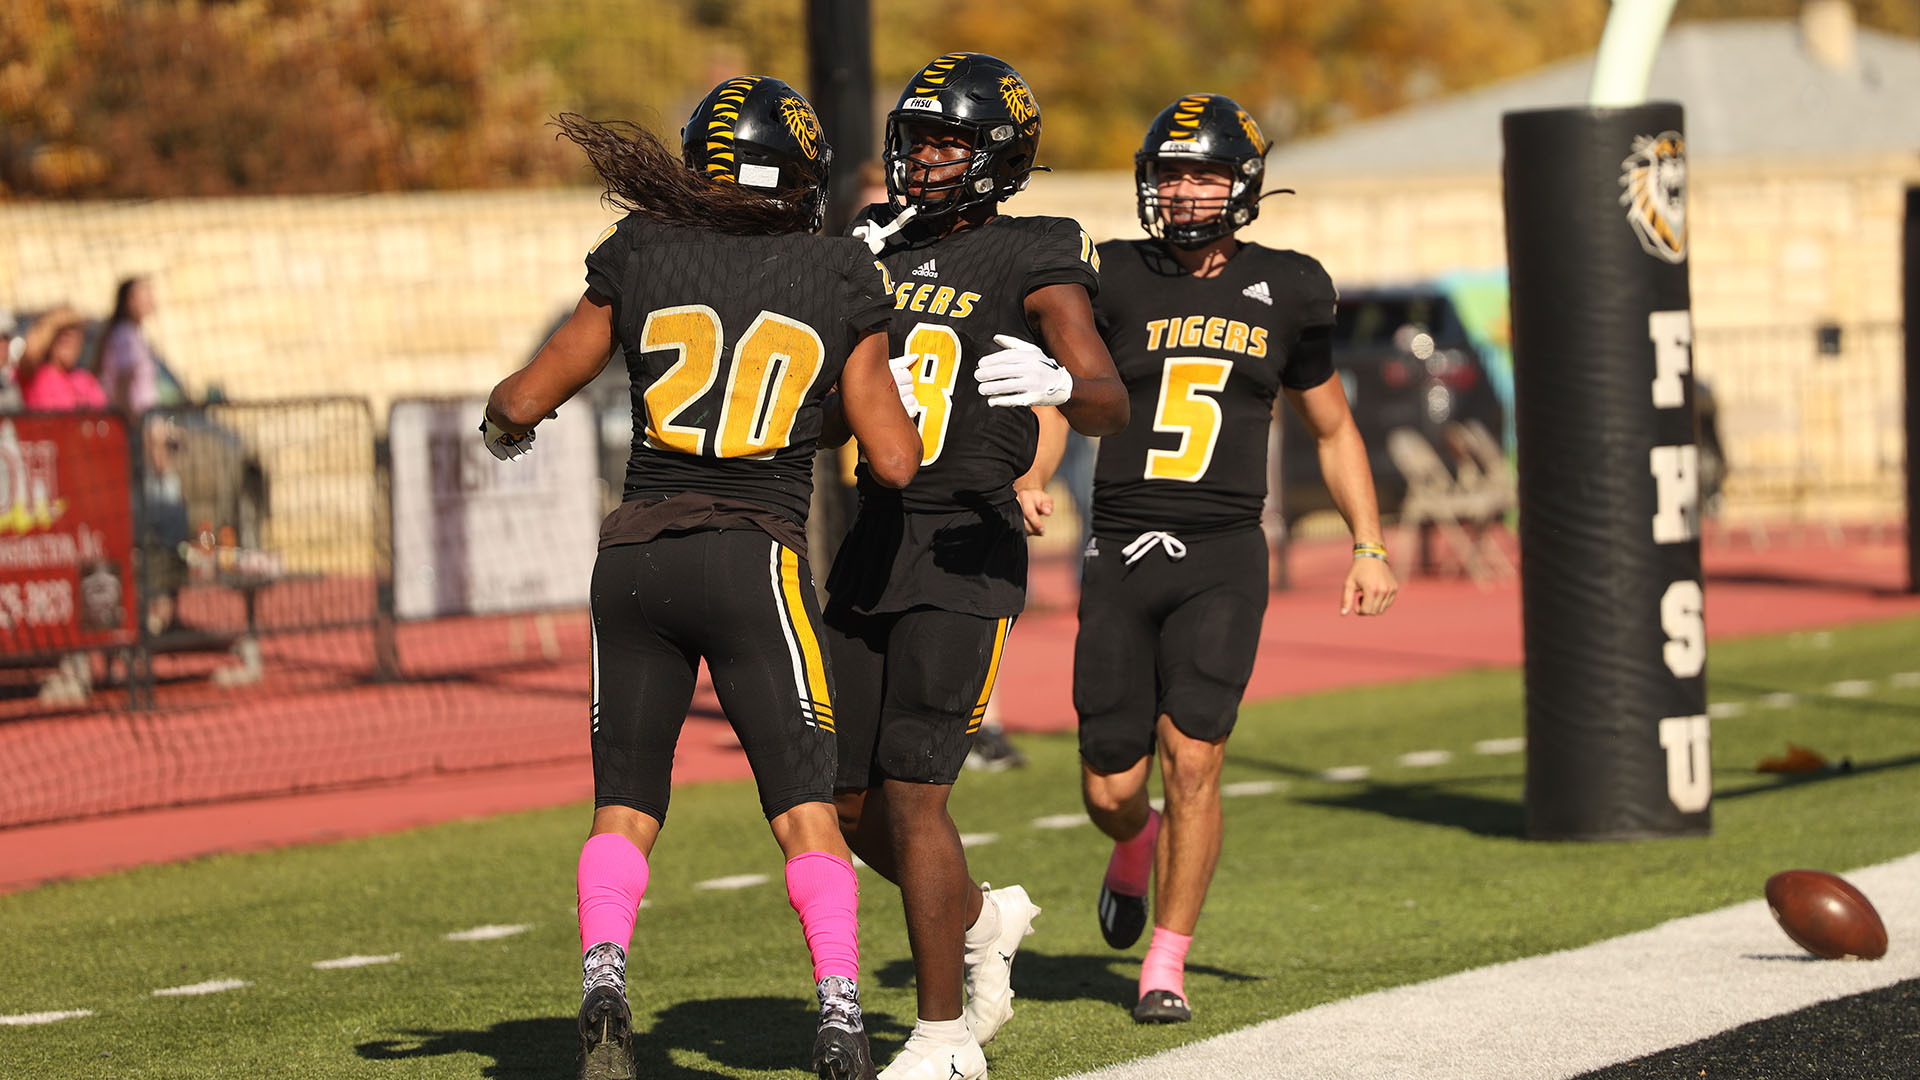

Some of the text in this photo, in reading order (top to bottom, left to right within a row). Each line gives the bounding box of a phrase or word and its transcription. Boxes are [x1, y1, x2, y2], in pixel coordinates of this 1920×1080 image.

[910, 98, 932, 108] FHSU
[911, 269, 938, 279] adidas
[893, 282, 982, 318] GERS
[1146, 315, 1269, 358] TIGERS
[640, 304, 826, 461] 20
[1144, 356, 1234, 483] 5
